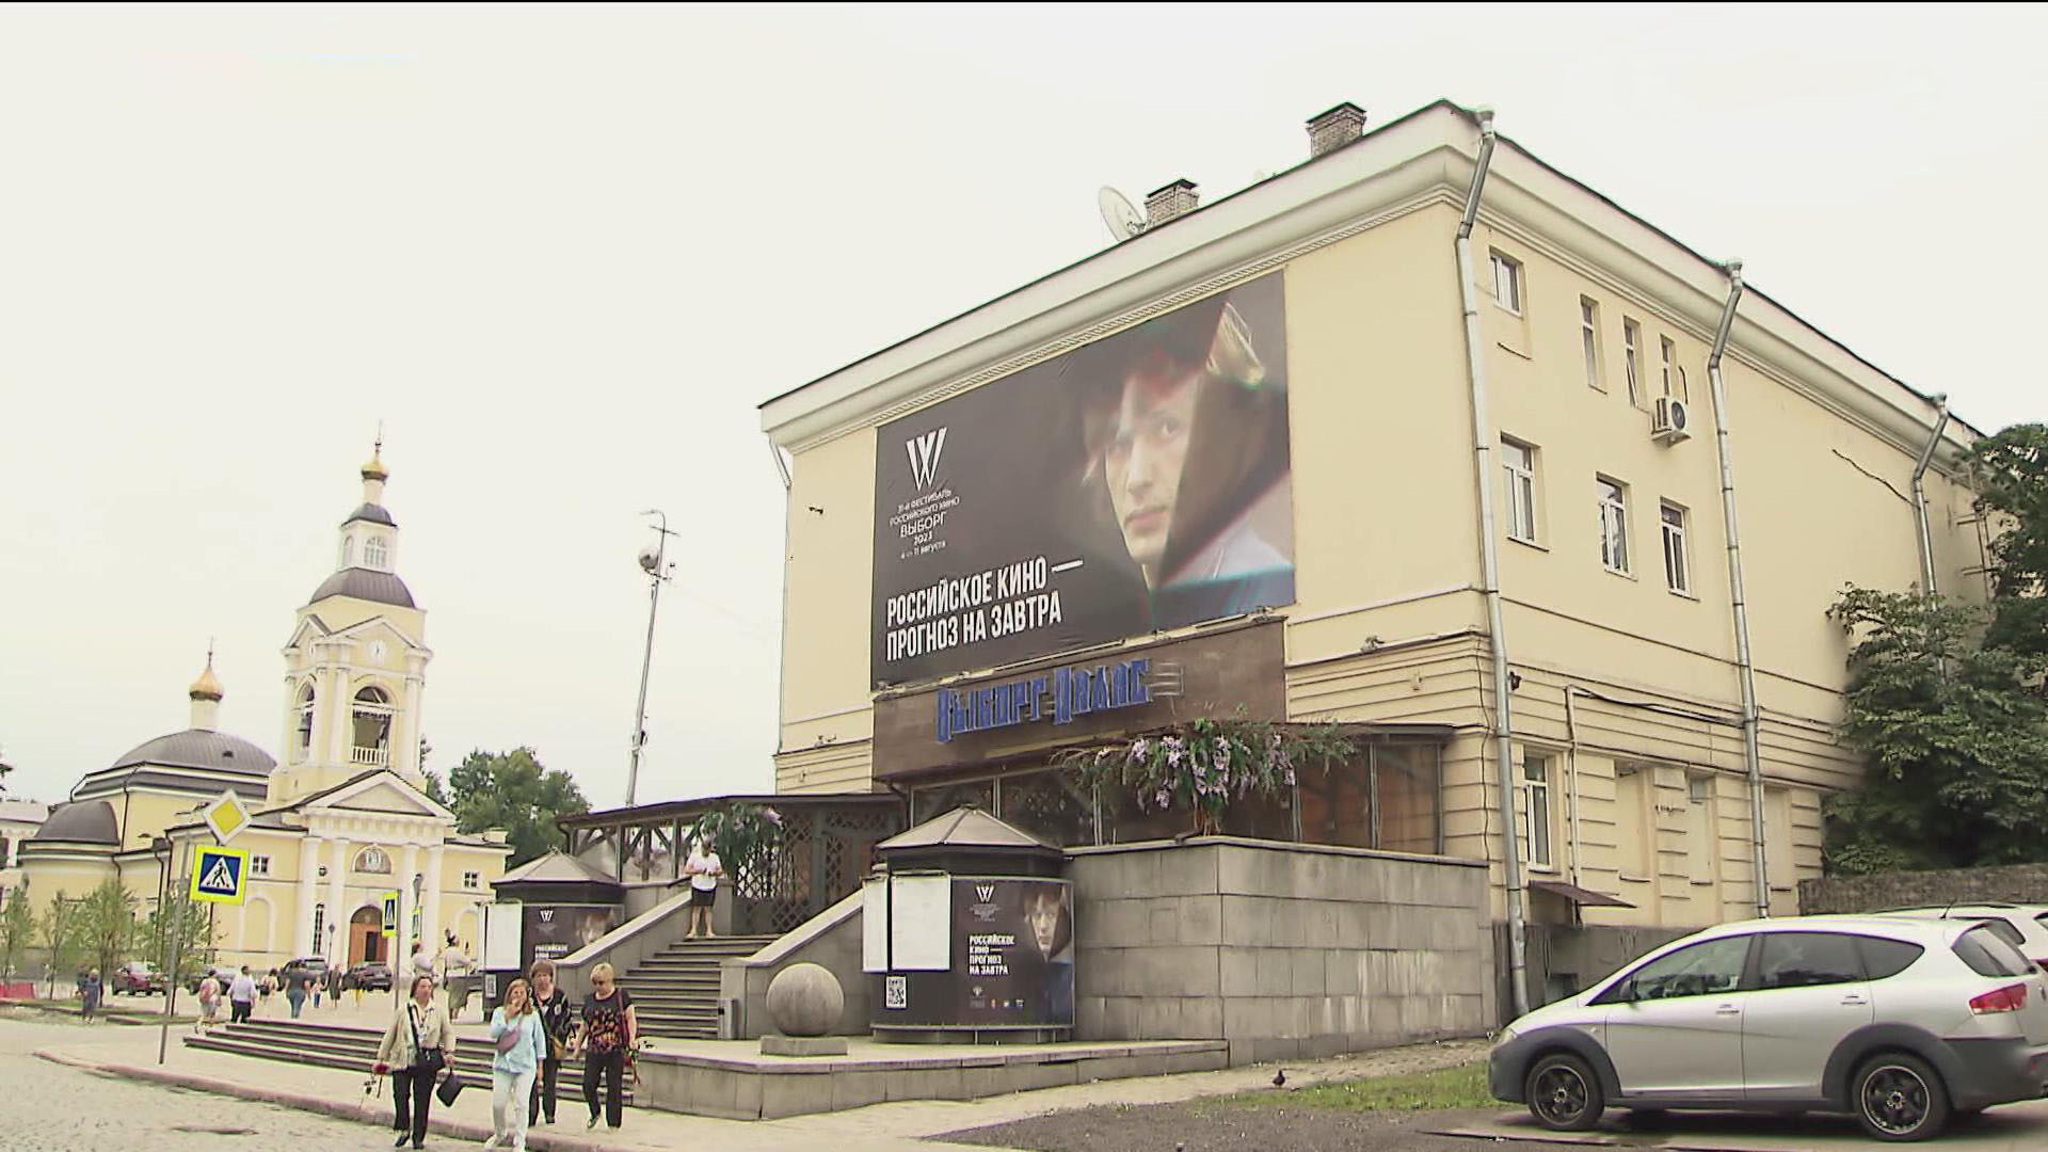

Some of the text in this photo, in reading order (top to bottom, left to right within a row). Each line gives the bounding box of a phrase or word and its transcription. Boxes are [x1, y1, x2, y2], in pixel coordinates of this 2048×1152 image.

[900, 511, 947, 538] ВЫБОРГ
[886, 571, 993, 628] РОССИЙСКОЕ
[997, 555, 1047, 600] КИНО
[886, 590, 1062, 662] ПРОГНОЗ НА ЗАВТРА
[969, 933, 1015, 945] РОССИЙСКОЕ
[969, 955, 1002, 965] ПРОГНОЗ
[969, 965, 1009, 975] НА ЗАВТРА
